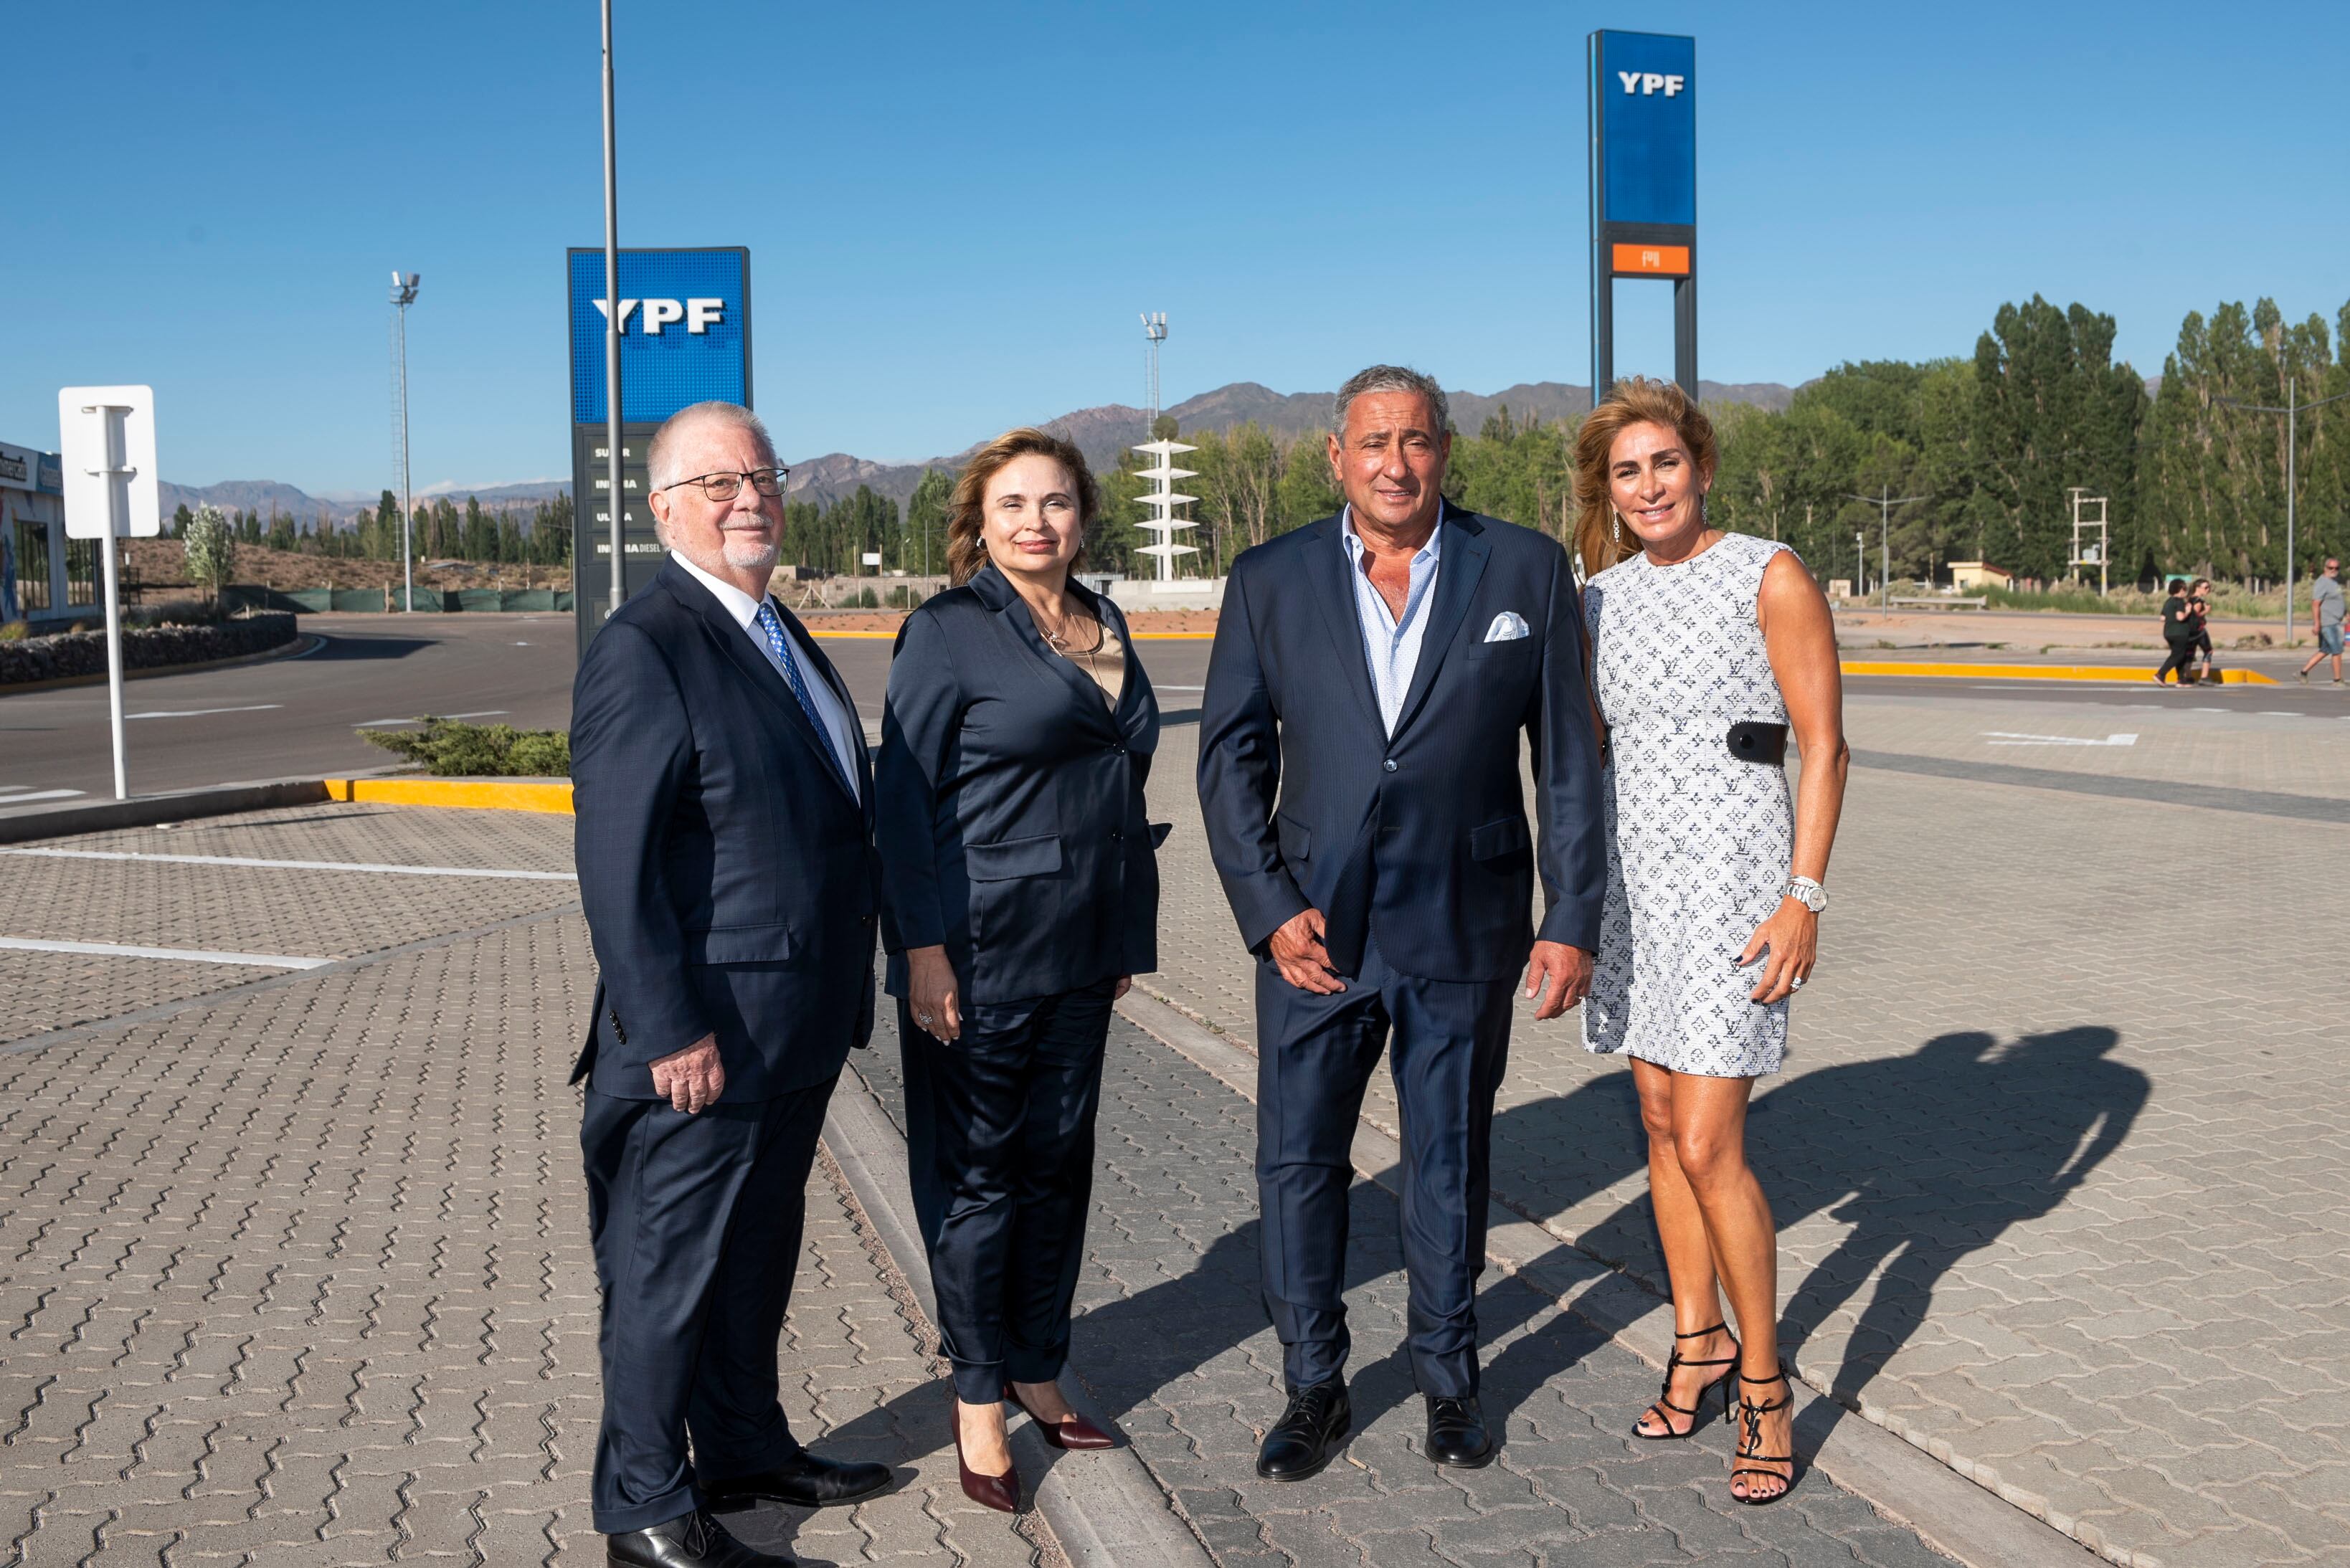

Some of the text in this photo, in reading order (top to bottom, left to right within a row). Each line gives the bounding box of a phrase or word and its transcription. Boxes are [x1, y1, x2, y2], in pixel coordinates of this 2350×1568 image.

[1618, 71, 1684, 97] YPF
[591, 298, 723, 334] YPF
[595, 447, 630, 457] SUR
[597, 512, 632, 522] ULA
[639, 543, 660, 553] DIESEL
